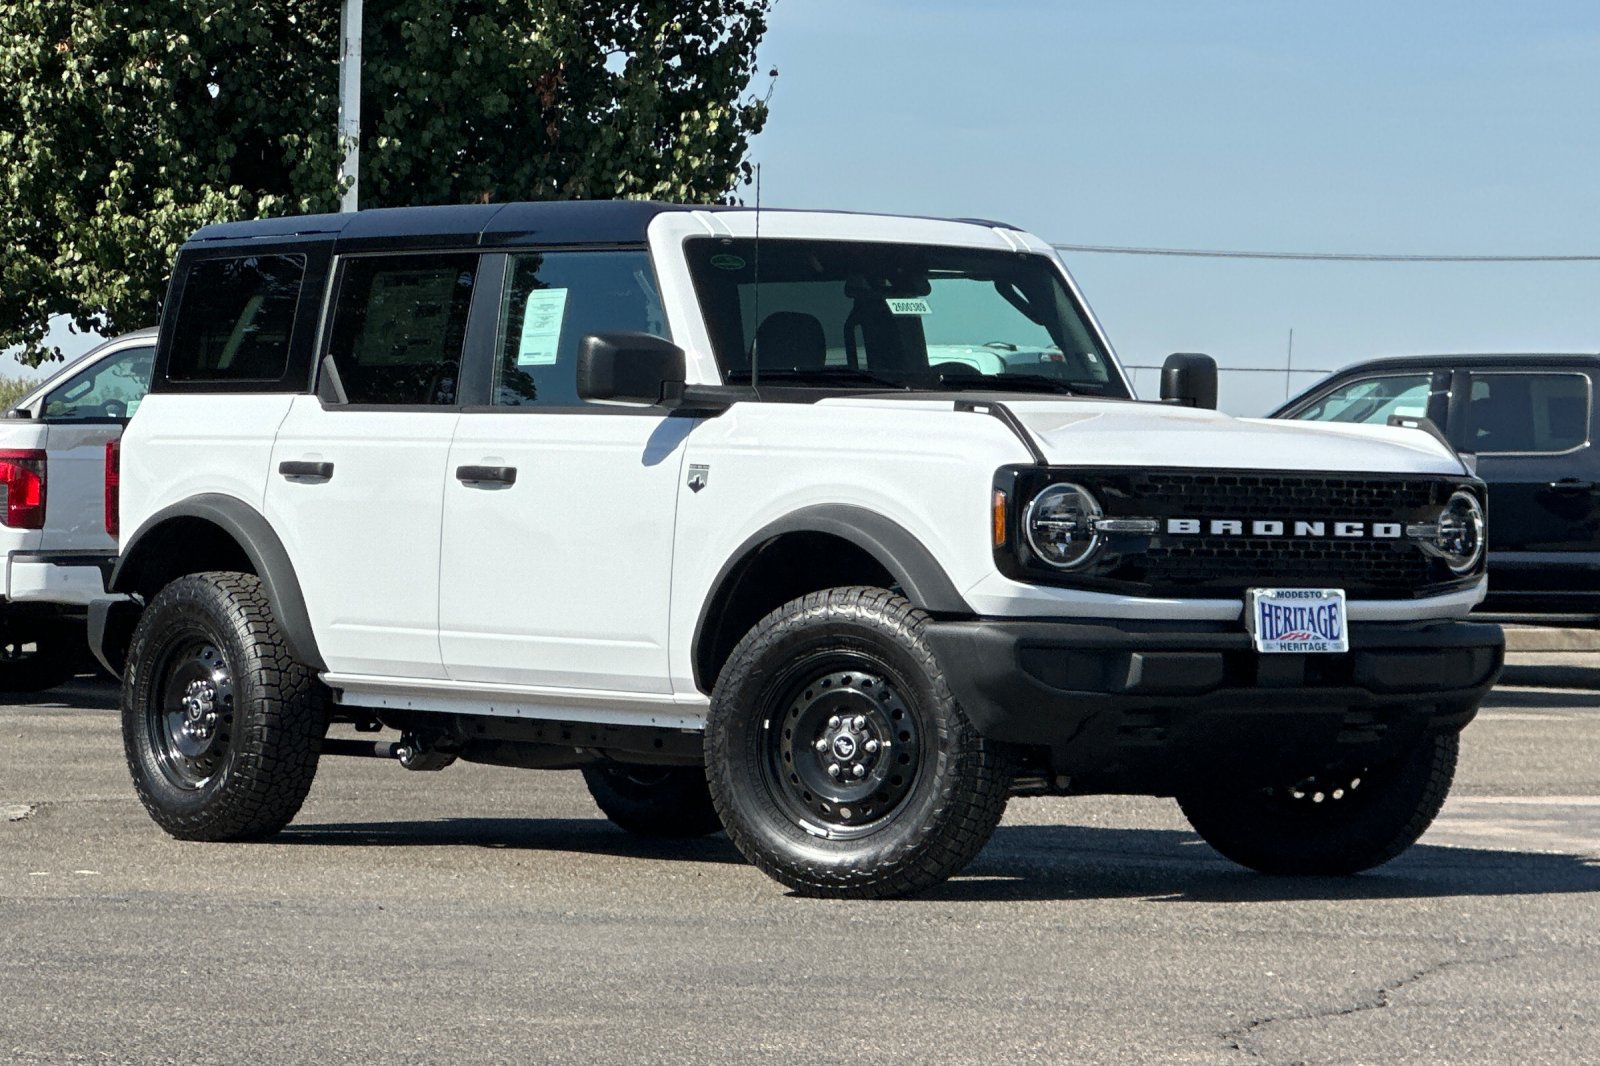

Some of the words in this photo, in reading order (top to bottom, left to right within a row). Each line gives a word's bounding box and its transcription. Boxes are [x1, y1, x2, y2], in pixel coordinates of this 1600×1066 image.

[1167, 518, 1401, 538] BRONCO
[1276, 591, 1322, 599] MODESTO
[1260, 602, 1341, 641] HERITAGE
[1280, 642, 1328, 651] HERITAGE
